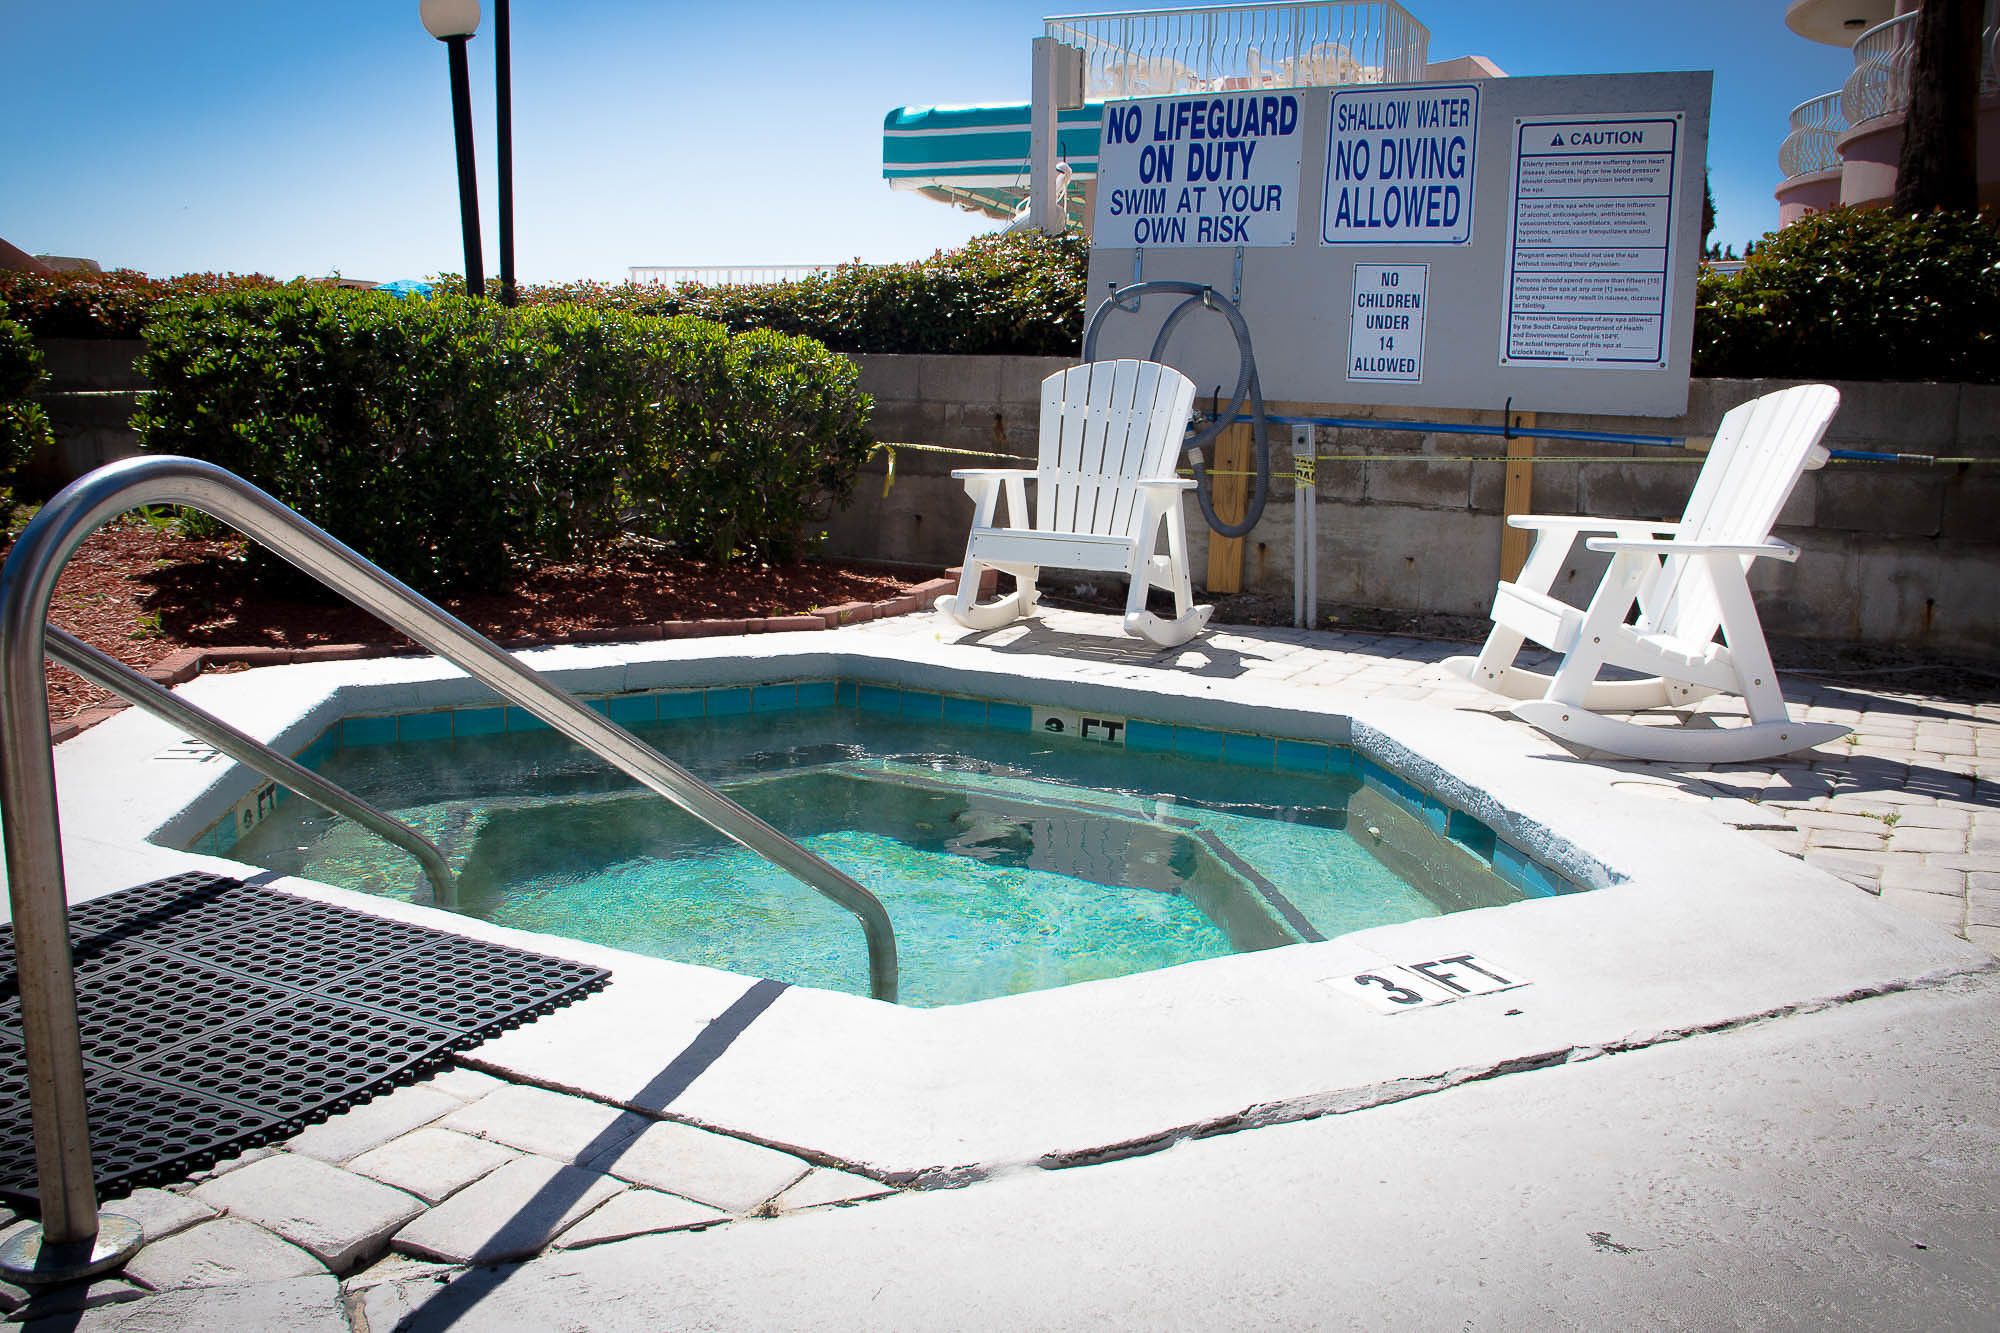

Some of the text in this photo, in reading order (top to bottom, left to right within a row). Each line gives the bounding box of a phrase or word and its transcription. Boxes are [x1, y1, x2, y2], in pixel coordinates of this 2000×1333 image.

[1107, 96, 1297, 144] NO LIFEGUARD
[1338, 99, 1470, 131] SHALLOW WATER
[1570, 131, 1644, 145] CAUTION
[1140, 141, 1256, 184] ON DUTY
[1336, 136, 1465, 180] NO DIVING
[1111, 185, 1282, 215] SWIM AT YOUR
[1335, 185, 1460, 228] ALLOWED
[1135, 215, 1250, 243] OWN RISK
[1382, 272, 1399, 286] NO
[1358, 293, 1420, 308] CHILDREN
[1367, 315, 1409, 329] UNDER
[1381, 336, 1393, 350] 14
[1355, 357, 1415, 372] ALLOWED
[1354, 954, 1513, 1005] 3 FT
